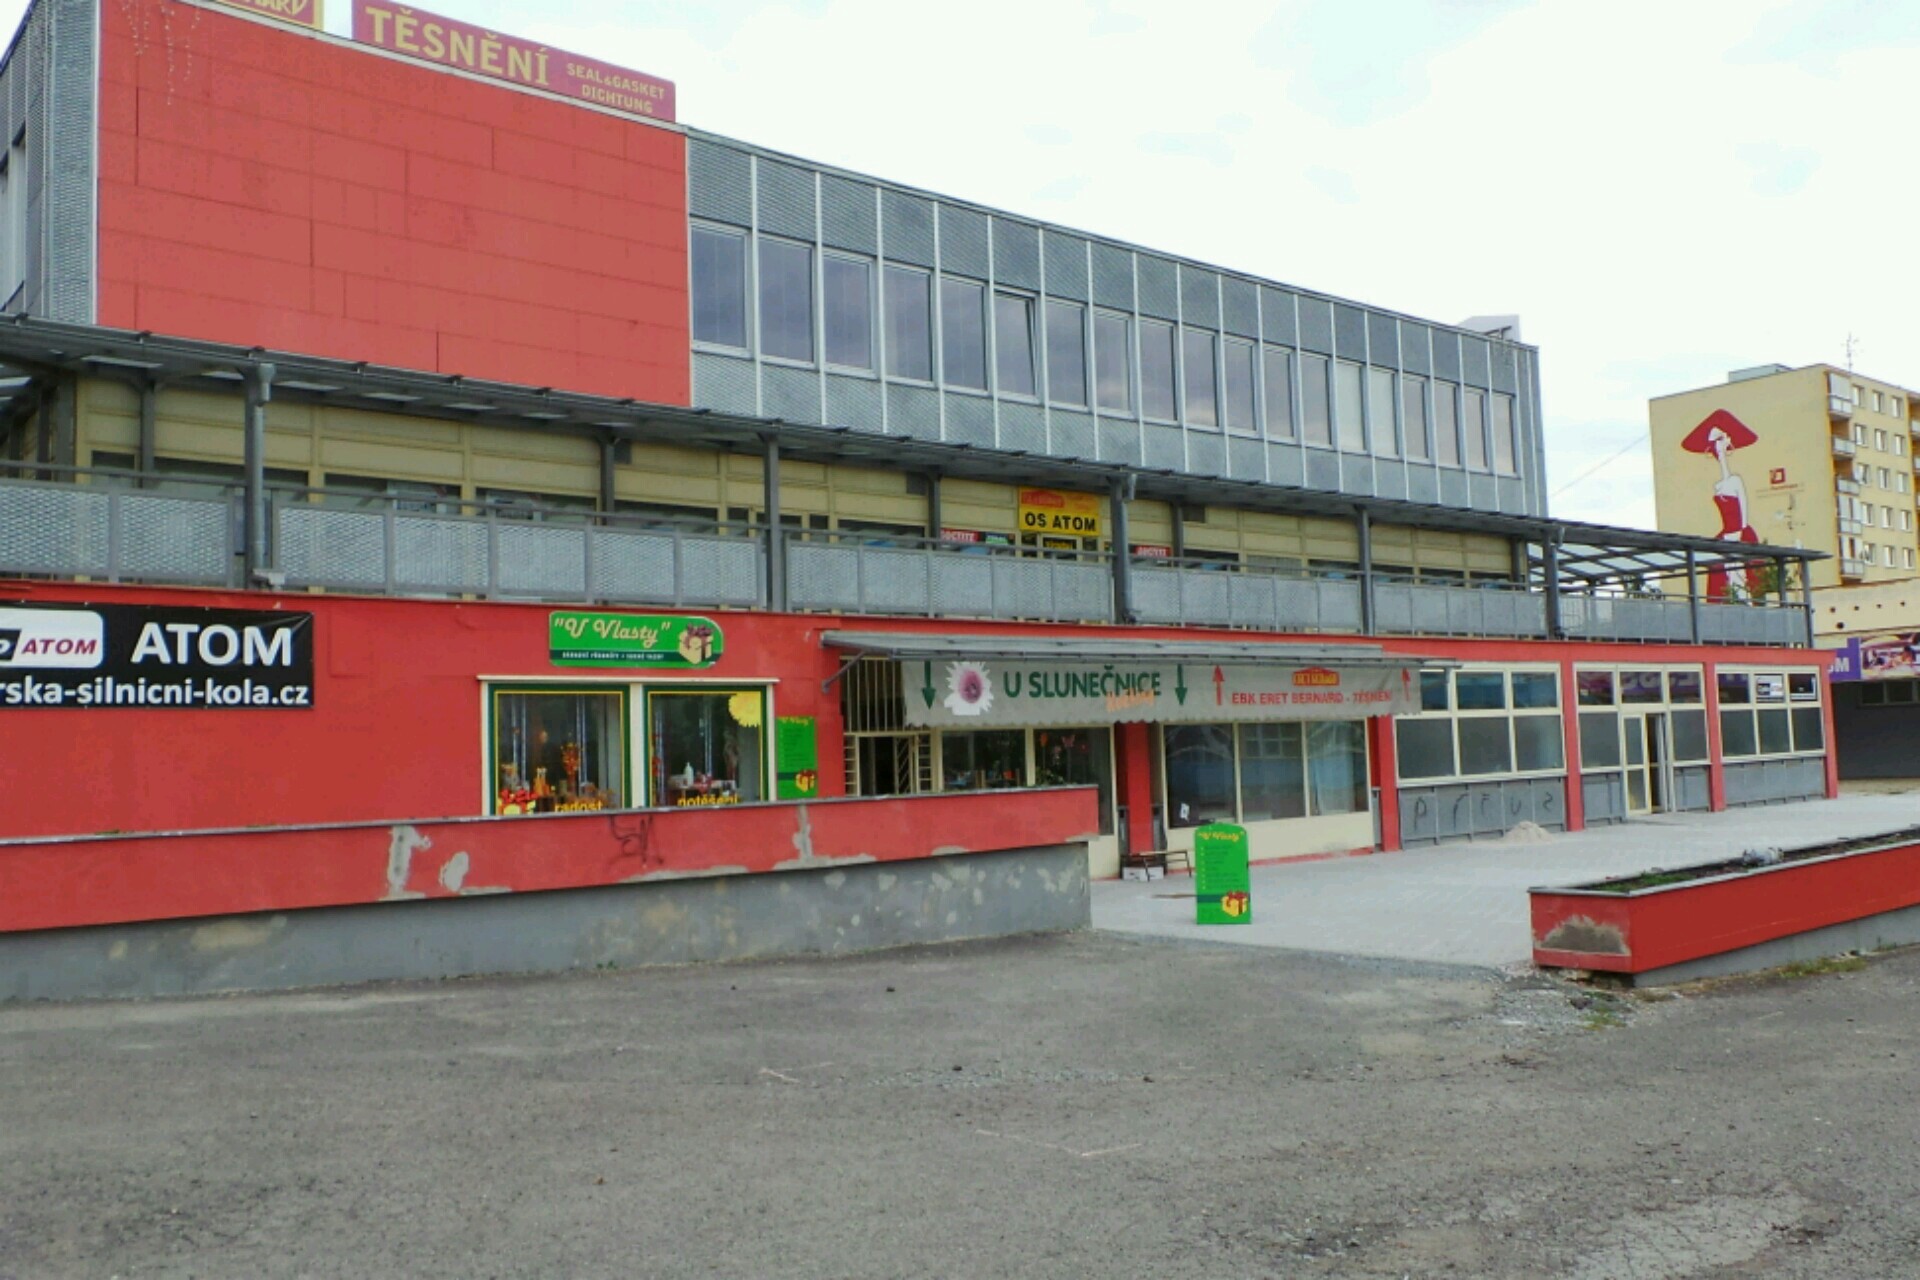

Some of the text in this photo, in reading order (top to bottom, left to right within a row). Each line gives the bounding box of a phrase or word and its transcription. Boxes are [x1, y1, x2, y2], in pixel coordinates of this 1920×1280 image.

[365, 6, 549, 86] TĚSNĚNÍ
[581, 84, 653, 113] DICHTUNG
[1025, 511, 1096, 532] OS ATOM
[21, 638, 97, 655] ATOM
[130, 621, 292, 667] ATOM
[1003, 664, 1162, 698] U SLUNEČNICE
